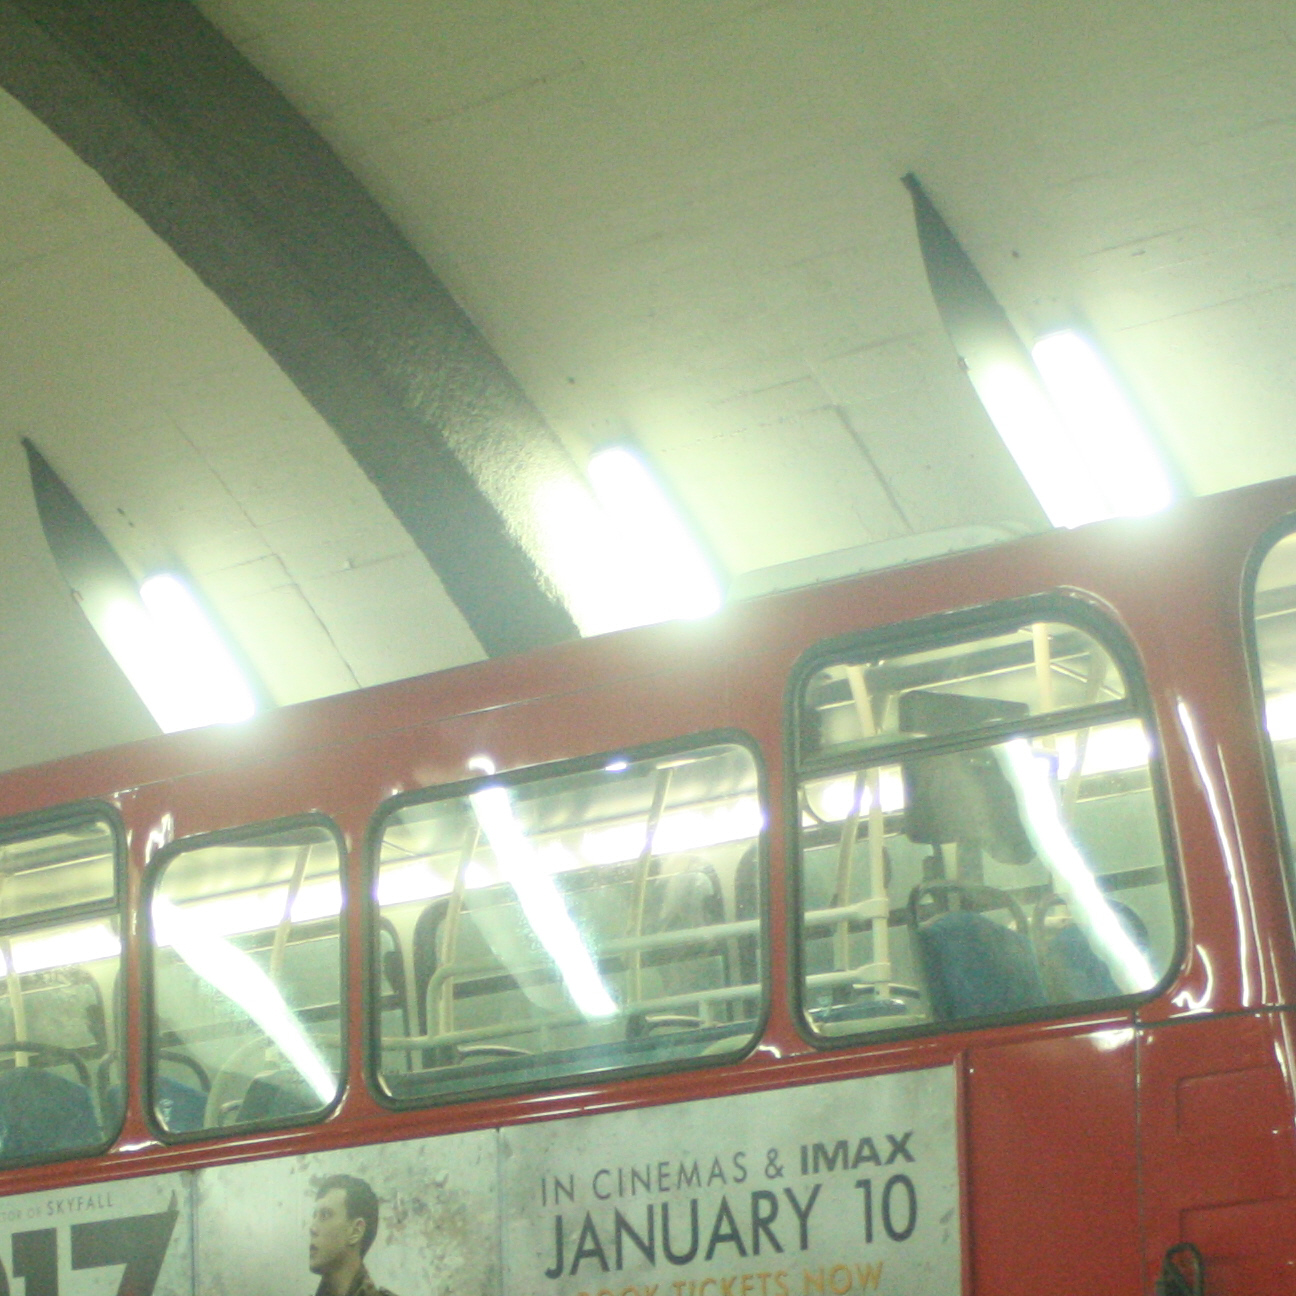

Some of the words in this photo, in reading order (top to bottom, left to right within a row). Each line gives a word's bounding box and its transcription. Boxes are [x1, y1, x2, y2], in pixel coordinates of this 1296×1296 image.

[540, 1174, 575, 1206] IN
[592, 1151, 748, 1200] CINEMAS
[764, 1147, 785, 1179] &
[800, 1131, 916, 1176] IMAX
[46, 1192, 113, 1216] SKYFALL
[545, 1183, 823, 1280] JANUARY
[854, 1173, 918, 1245] 10
[803, 1261, 885, 1296] NOW
